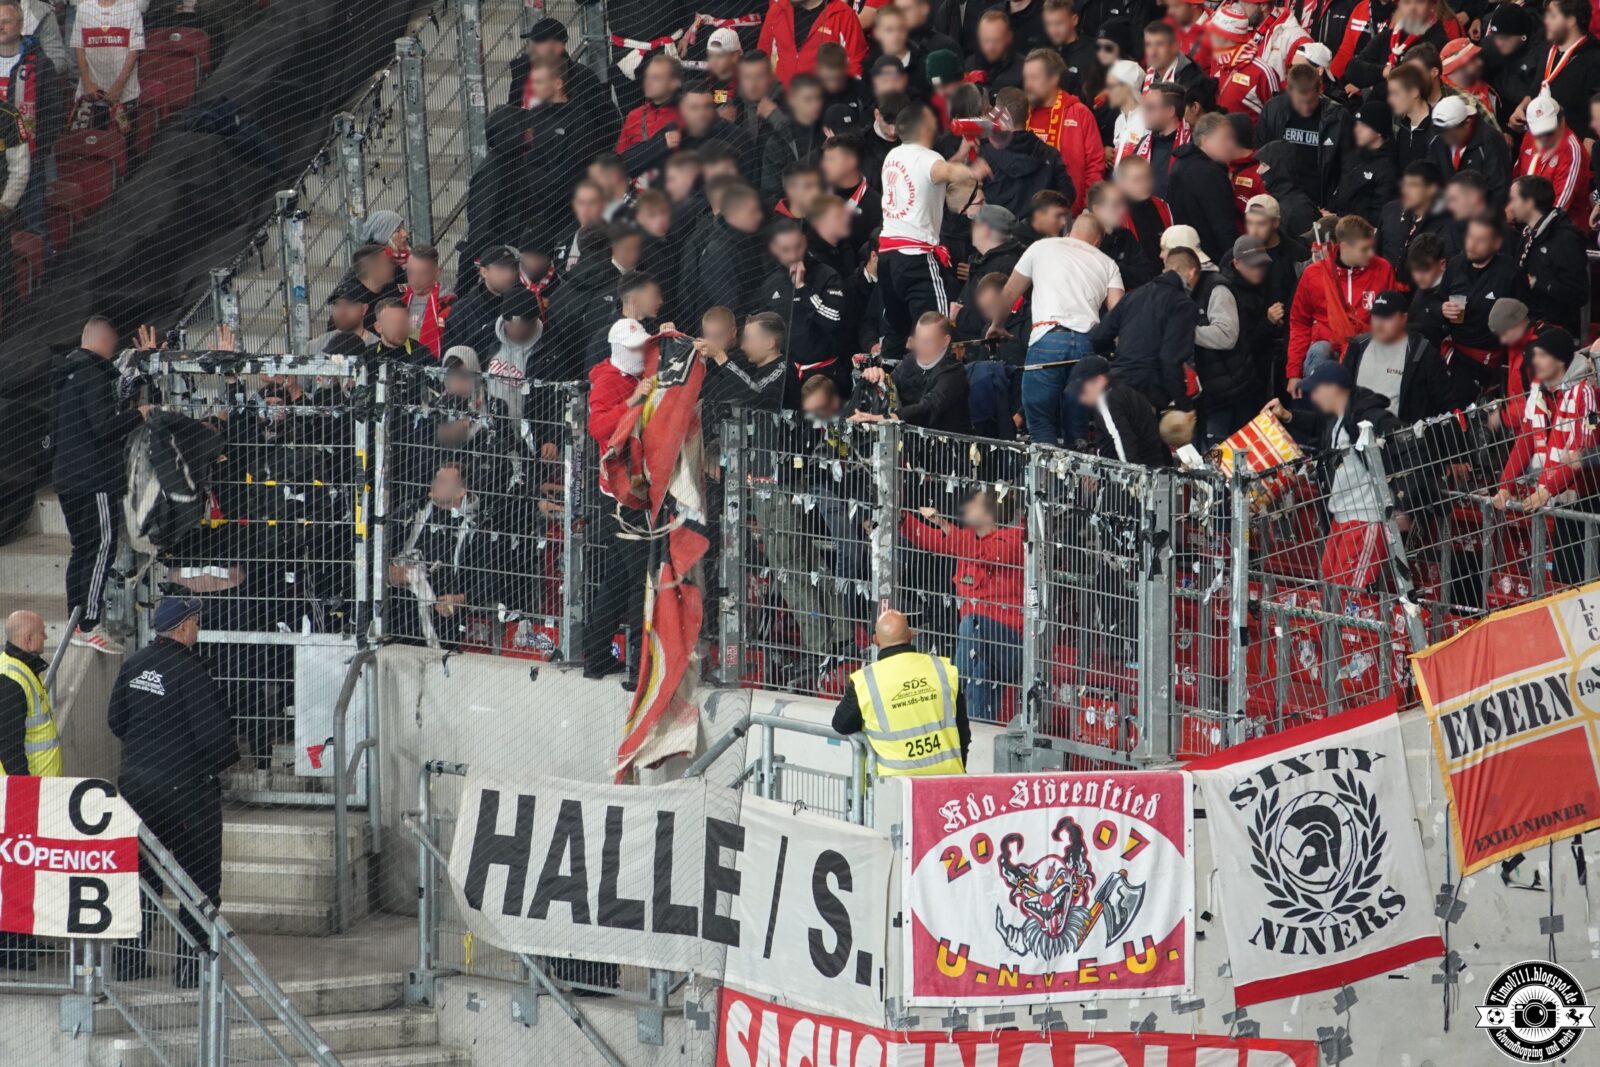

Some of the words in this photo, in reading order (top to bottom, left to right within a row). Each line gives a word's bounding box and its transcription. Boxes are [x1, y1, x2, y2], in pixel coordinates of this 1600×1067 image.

[1283, 128, 1304, 142] ERN
[903, 174, 916, 207] UNION
[1583, 612, 1595, 628] F
[141, 670, 163, 683] SDS
[903, 677, 927, 691] SDS
[891, 693, 938, 709] www.sds-bw.de
[1441, 673, 1574, 759] EISERN
[905, 733, 942, 758] 2554
[1229, 747, 1387, 811] SIXTY
[68, 778, 118, 836] C
[1008, 778, 1161, 821] Störenfried
[1475, 803, 1587, 853] EXILUNIONER
[0, 834, 117, 870] KÖPENICK
[67, 876, 113, 935] B
[1249, 885, 1406, 955] NINERS
